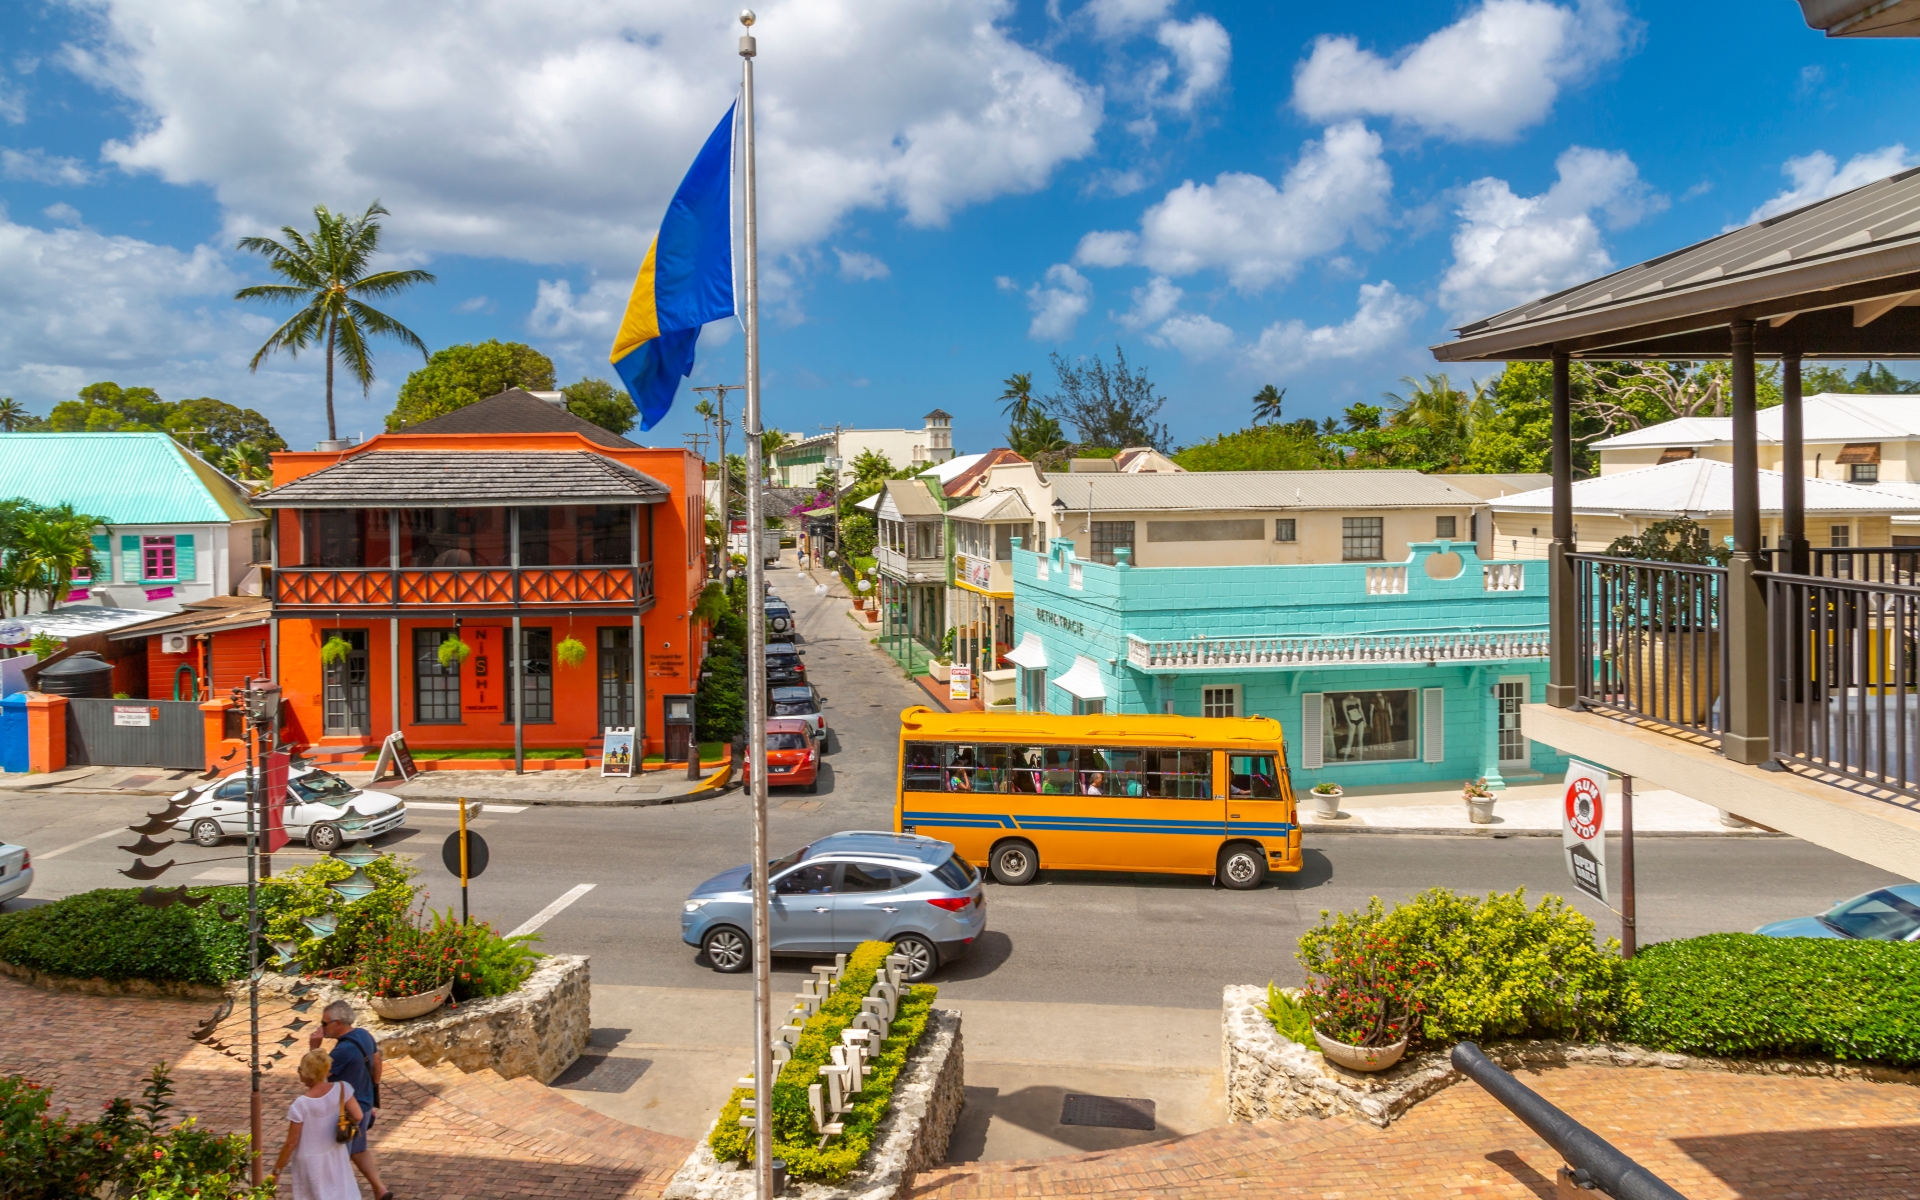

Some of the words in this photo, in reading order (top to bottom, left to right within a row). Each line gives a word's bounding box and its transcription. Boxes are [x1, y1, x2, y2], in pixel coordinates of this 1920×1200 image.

[1575, 780, 1598, 799] RUM
[1570, 816, 1596, 838] STOP
[1573, 853, 1596, 874] OPEN
[1575, 865, 1597, 886] DAILY
